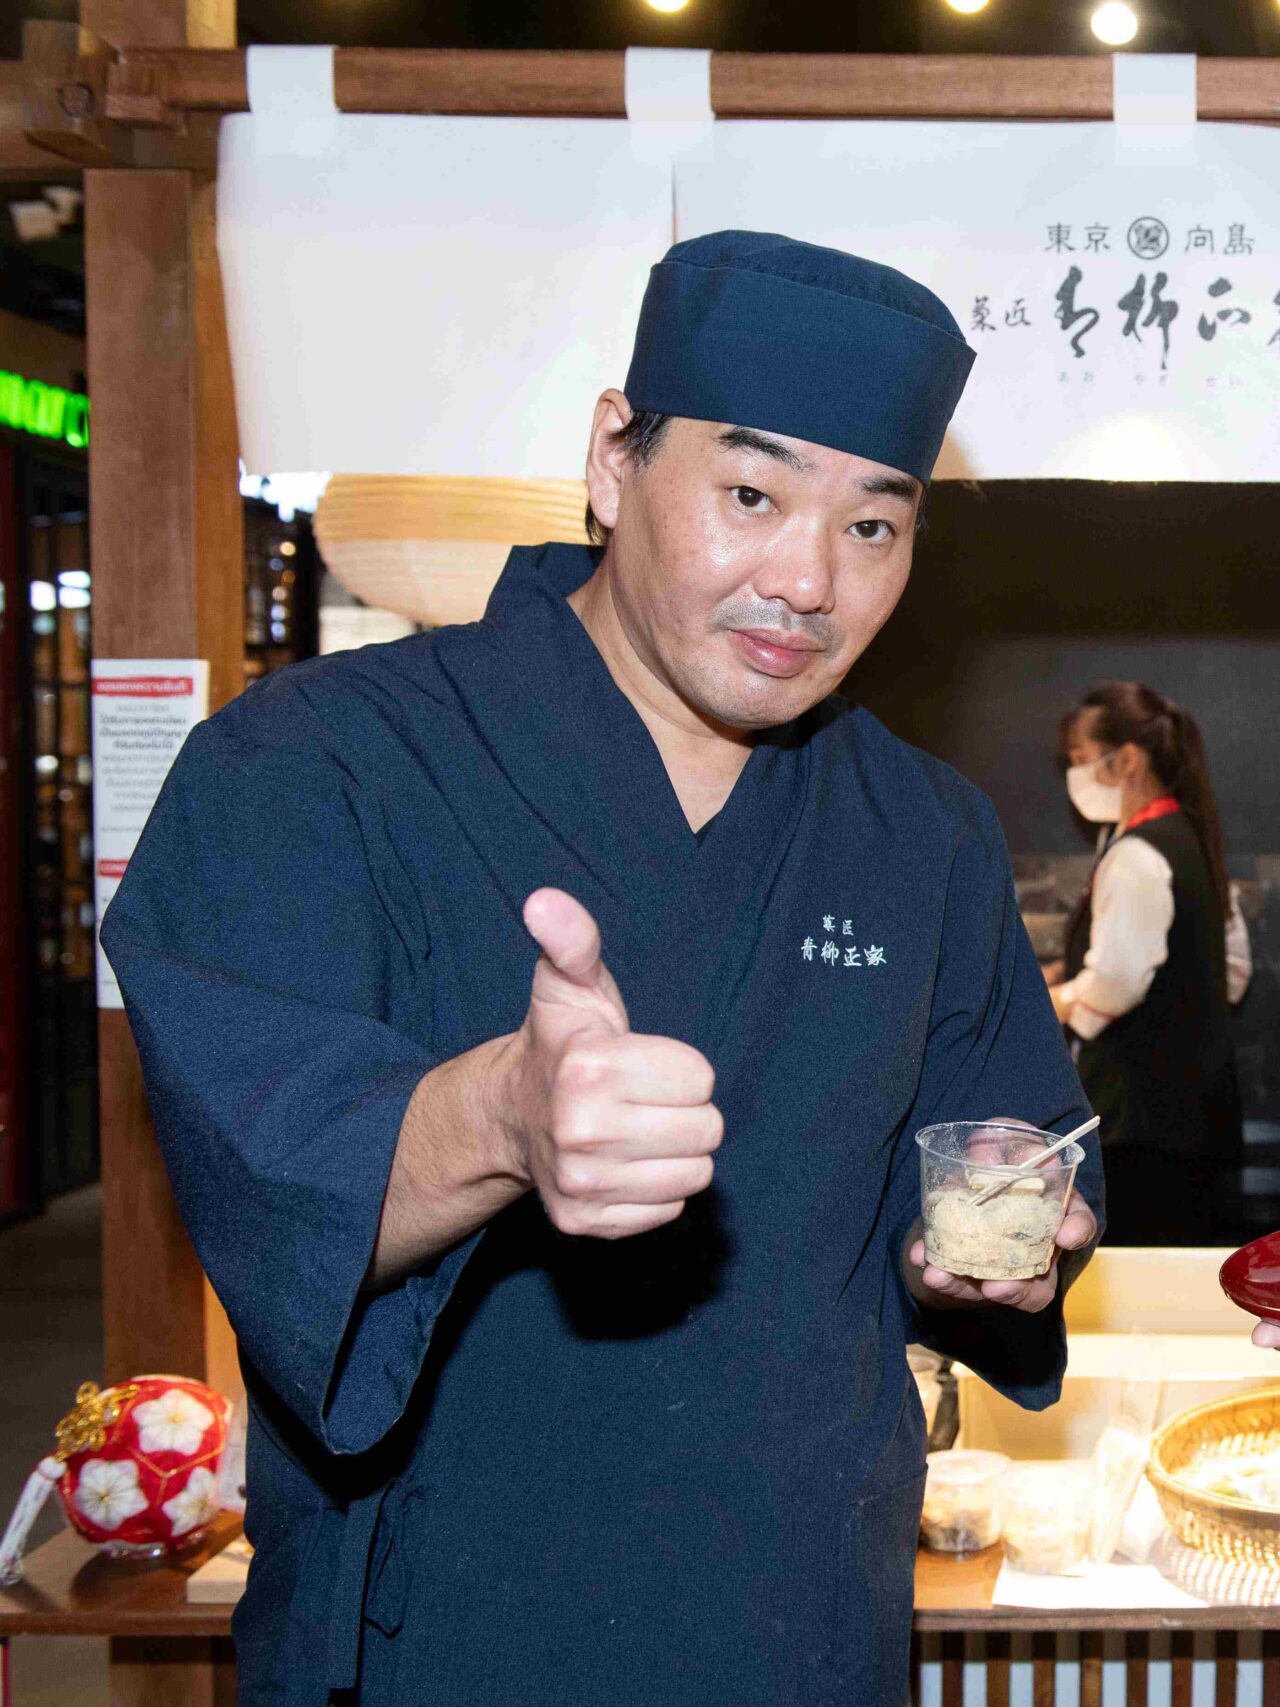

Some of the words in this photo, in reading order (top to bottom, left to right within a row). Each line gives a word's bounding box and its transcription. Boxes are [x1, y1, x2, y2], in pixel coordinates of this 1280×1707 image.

[1044, 221, 1112, 253] 東京
[1183, 222, 1256, 256] 向島
[969, 296, 1032, 332] 菓匠
[822, 914, 854, 936] 菓匠
[800, 936, 888, 967] 青柳正家
